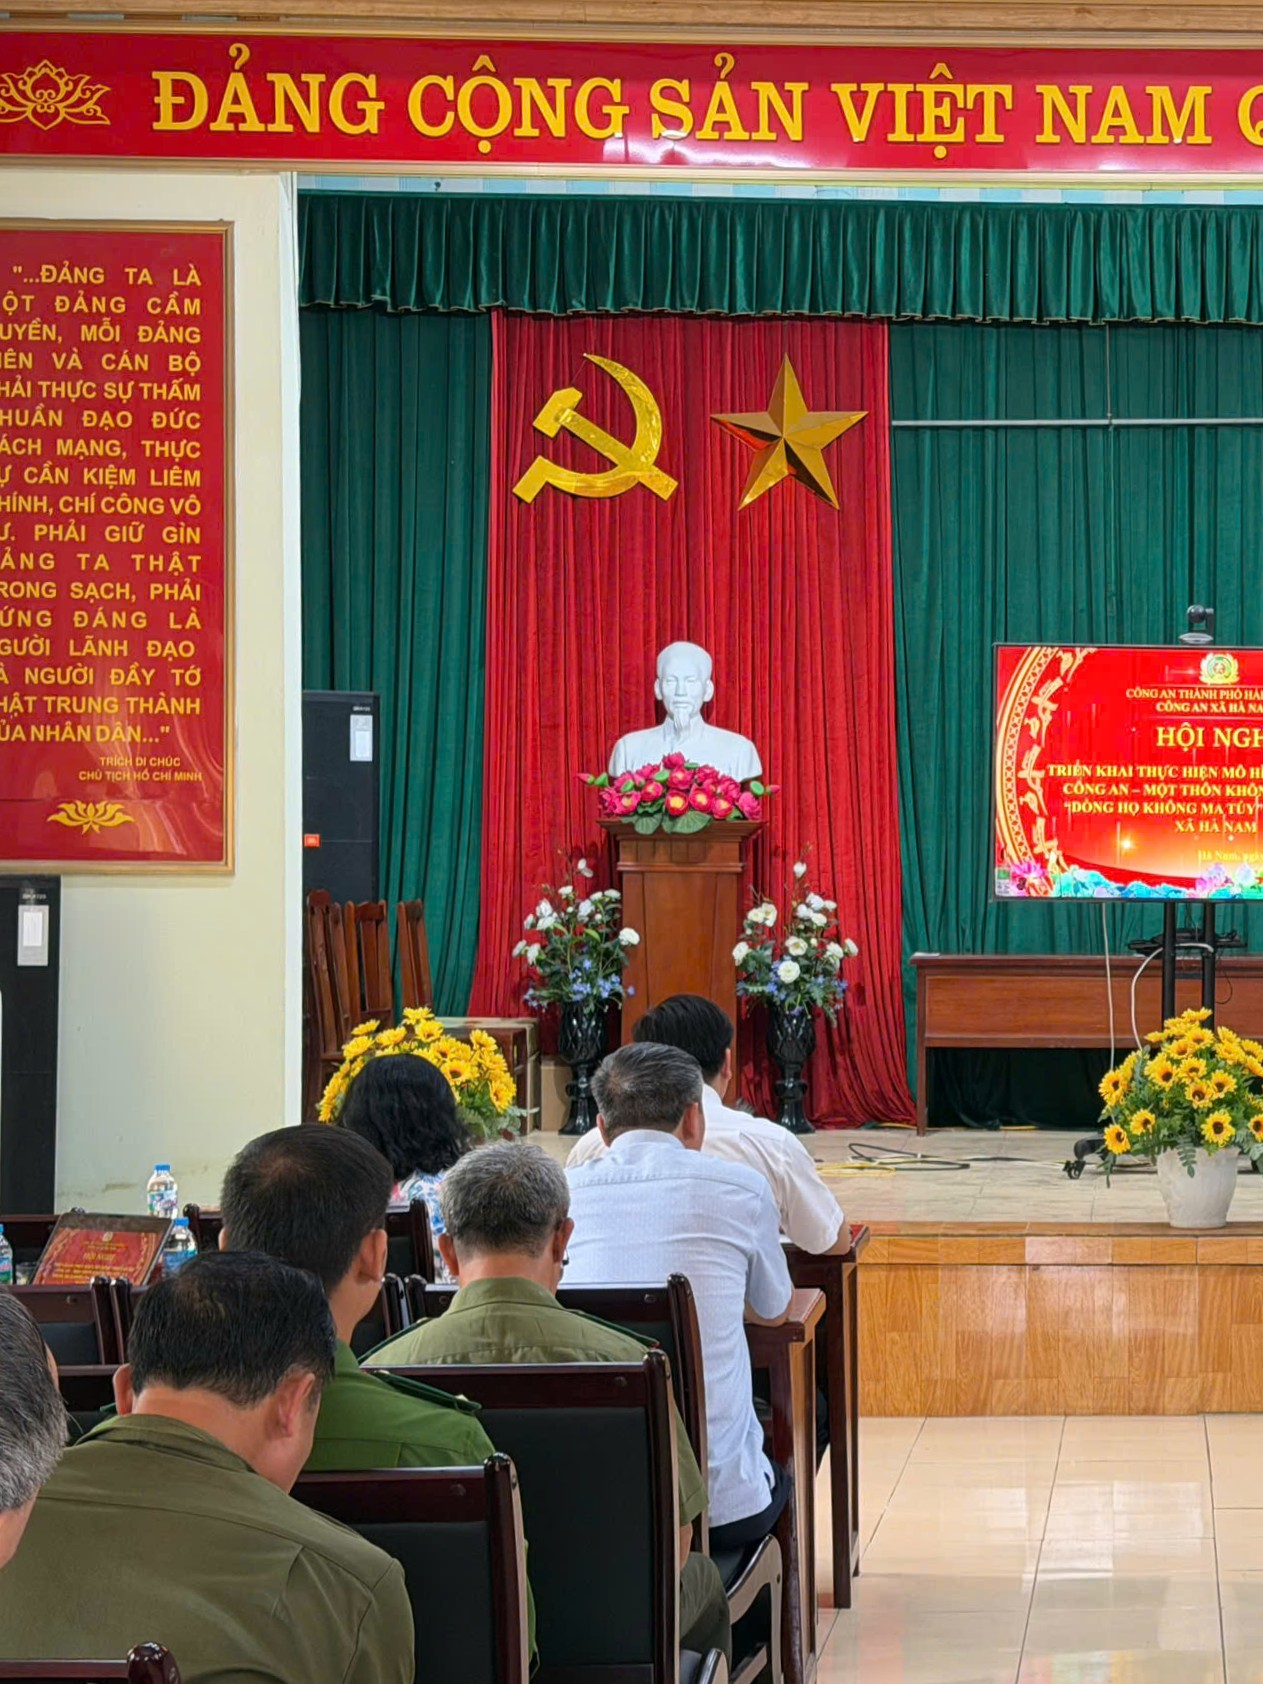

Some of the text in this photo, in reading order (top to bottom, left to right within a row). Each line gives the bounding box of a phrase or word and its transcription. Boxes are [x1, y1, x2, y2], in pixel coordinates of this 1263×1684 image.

[153, 44, 384, 134] ĐẢNG
[408, 55, 628, 158] CỘNG
[647, 53, 808, 146] SẢN
[831, 63, 1012, 158] VIỆT
[1036, 85, 1212, 144] NAM
[55, 291, 200, 315] ĐẢNG CẦM
[81, 318, 200, 343] MỖI ĐẢNG
[102, 350, 148, 370] CÁN
[38, 378, 200, 402] THỰC THẤM
[82, 408, 200, 430] ĐẠO ĐỨC
[57, 439, 200, 462] MẠNG, THỰC
[24, 461, 200, 489] CẦN KIỆM LIÊM
[59, 493, 164, 514] CHÍ CÔNG
[35, 519, 200, 543] PHẢI GIỮ GÌN
[132, 551, 201, 576] THẬT
[71, 578, 200, 603] SẠCH, PHẢI
[74, 607, 146, 628] ĐÁNG
[70, 635, 195, 661] LÃNH ĐẠO
[25, 662, 200, 686] NGƯỜI ĐẦY TỚ
[43, 692, 200, 715] TRUNG THÀNH
[31, 721, 91, 742] NHÂN
[1156, 722, 1204, 751] HỘI
[100, 755, 181, 767] TRÍCH DI CHÚC
[1096, 766, 1133, 777] KHAI
[1137, 766, 1178, 780] THỰC
[1182, 766, 1218, 780] HIỆN
[1222, 764, 1246, 779] MÔ
[105, 770, 203, 783] TỊCH CHÍ MINH
[1063, 781, 1105, 795] CÔNG
[1109, 784, 1129, 795] AN
[1144, 782, 1178, 798] MỘT
[1180, 782, 1221, 796] THÔN
[1118, 802, 1139, 816] HỌ
[1143, 799, 1197, 814] KHÔNG
[1201, 804, 1224, 814] MA
[1175, 819, 1257, 832] XÃ HÀ NAM
